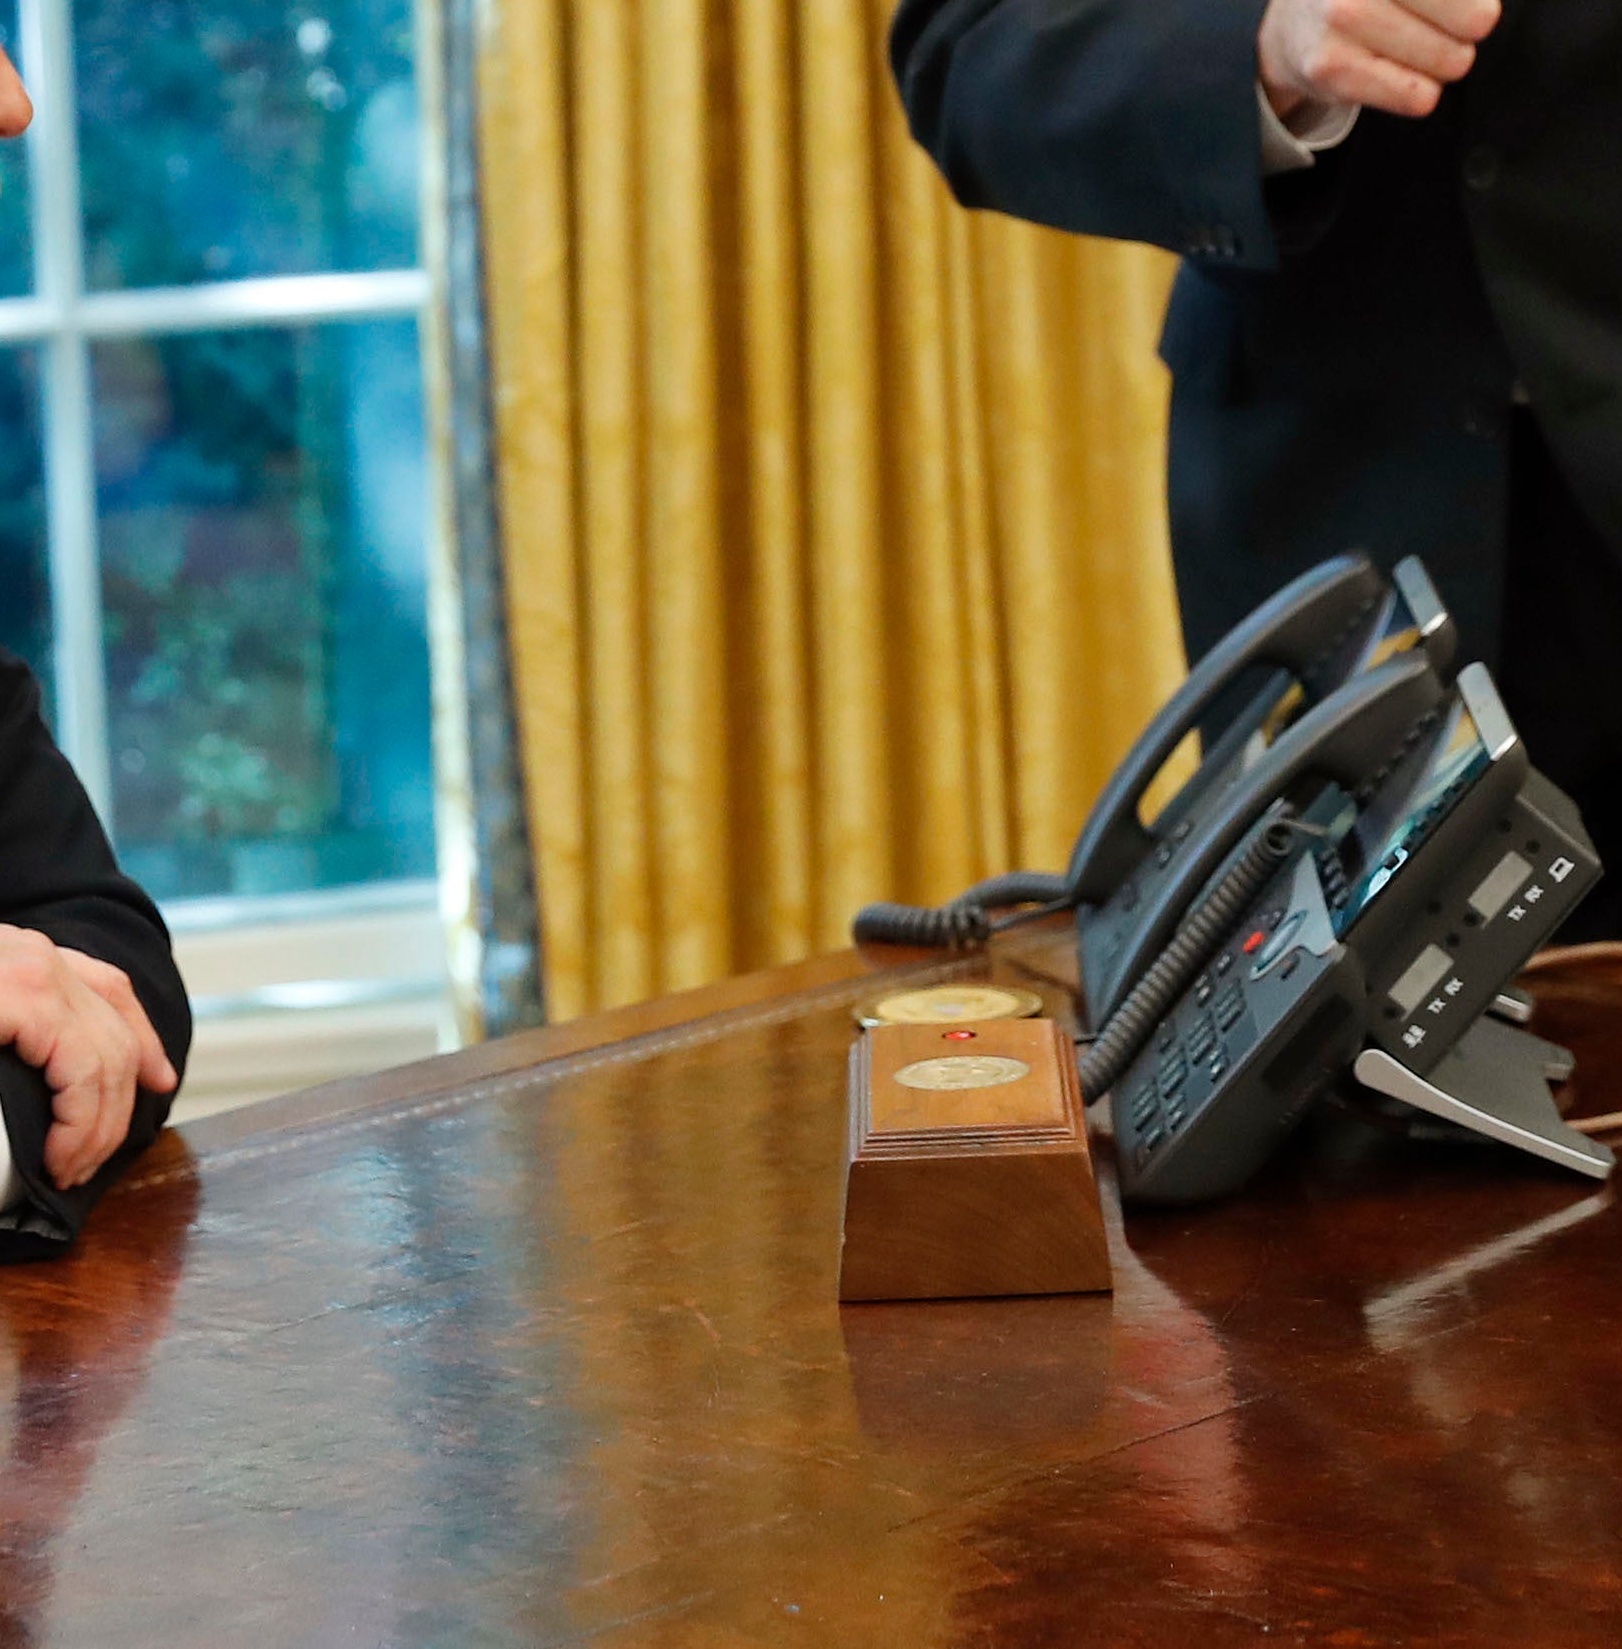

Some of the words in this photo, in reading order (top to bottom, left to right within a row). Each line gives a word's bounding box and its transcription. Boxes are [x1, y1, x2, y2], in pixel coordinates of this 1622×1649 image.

[1506, 904, 1527, 922] TX
[1524, 884, 1544, 904] RX
[1426, 997, 1447, 1015] TX
[1444, 977, 1464, 996] RX
